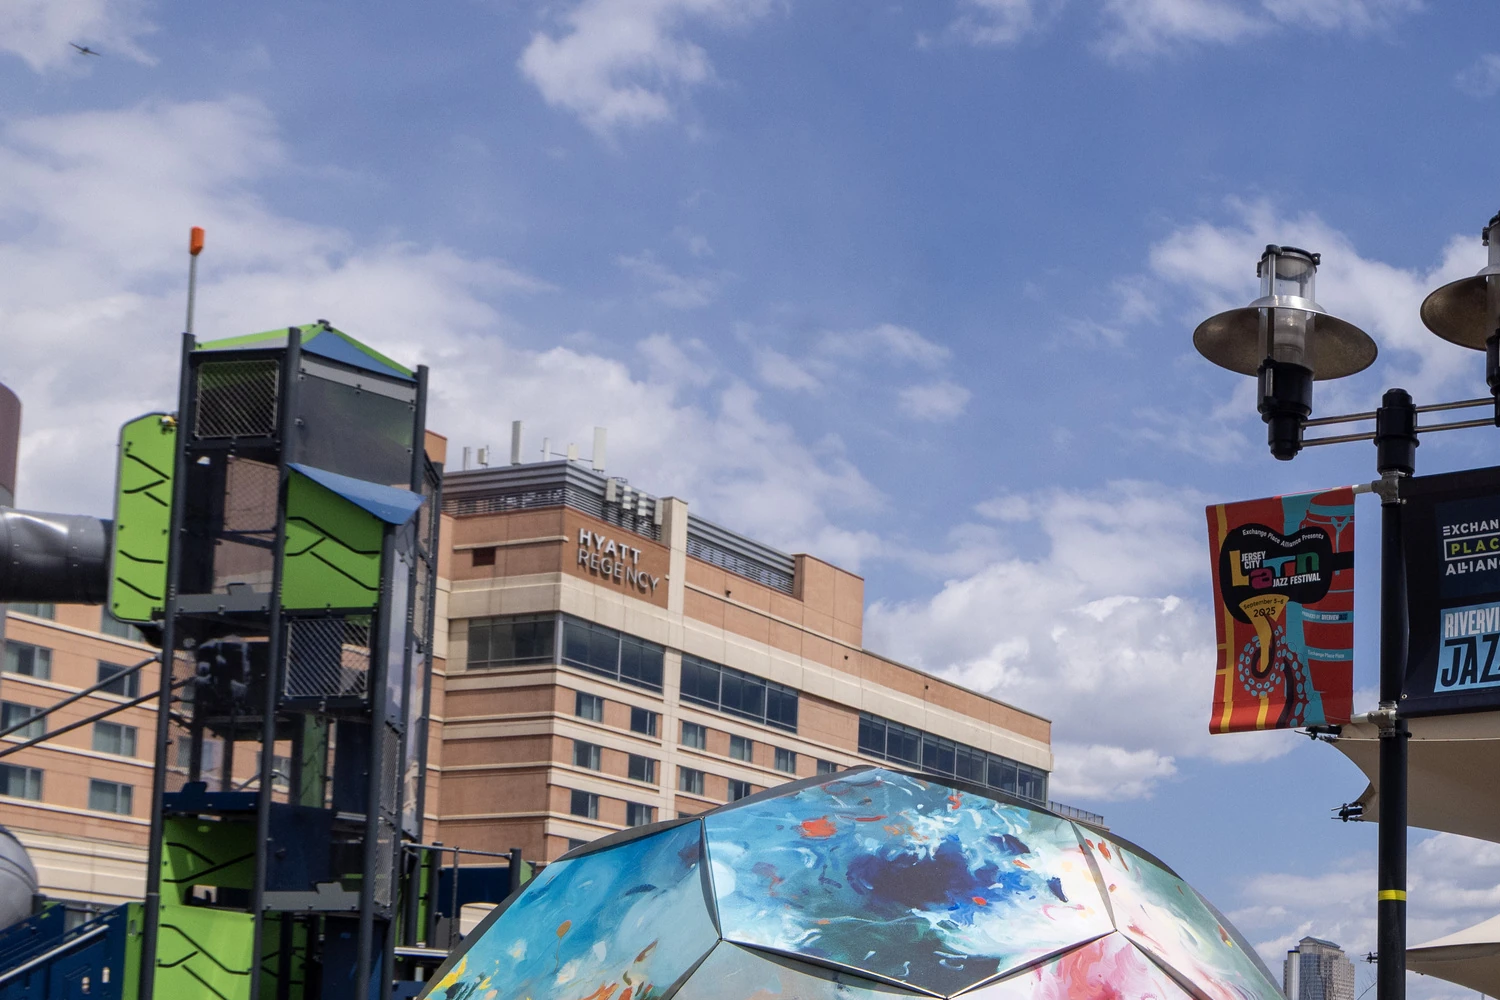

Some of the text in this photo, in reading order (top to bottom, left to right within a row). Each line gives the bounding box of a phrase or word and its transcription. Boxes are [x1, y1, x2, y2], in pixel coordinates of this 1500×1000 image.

[1242, 528, 1267, 538] Exchange
[1267, 533, 1281, 544] Place
[1280, 538, 1301, 548] Alliance
[579, 527, 642, 565] HYATT
[1241, 551, 1266, 562] JERSEY
[577, 547, 660, 591] REGENCY
[1244, 560, 1260, 570] CITY
[1272, 572, 1321, 588] JAZZ FESTIVAL
[1243, 598, 1273, 610] September
[1253, 606, 1276, 618] 2025
